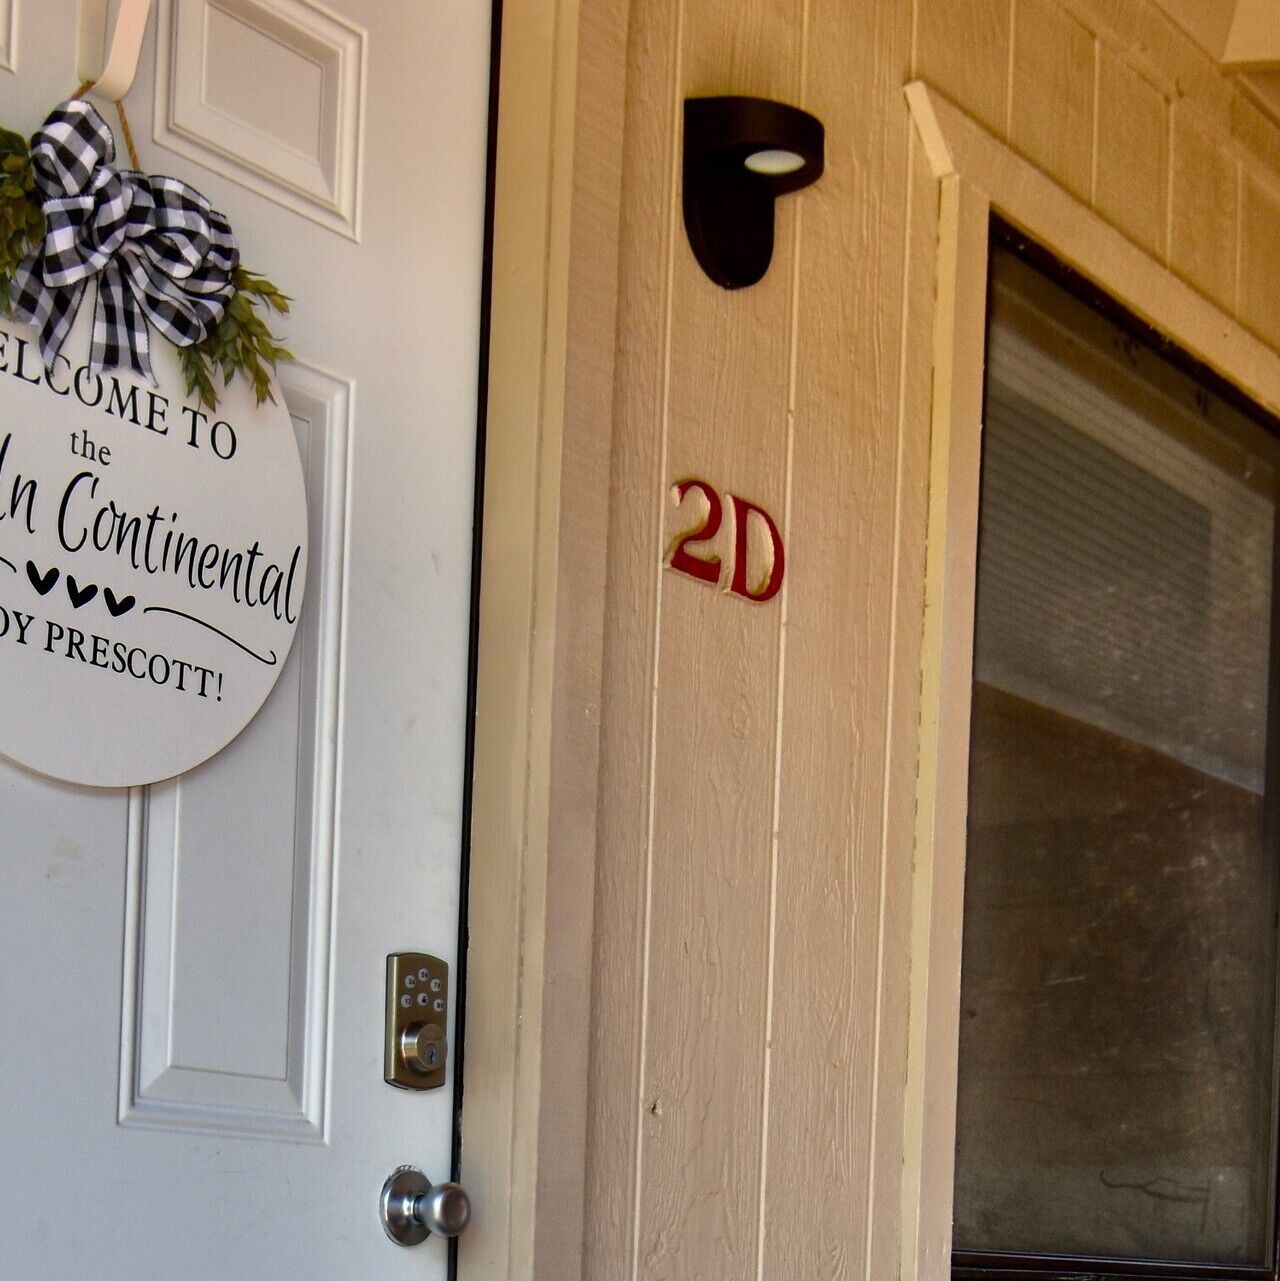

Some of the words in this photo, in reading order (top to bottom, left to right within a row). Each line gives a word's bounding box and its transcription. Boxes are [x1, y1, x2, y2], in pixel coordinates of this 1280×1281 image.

[70, 429, 111, 466] the
[181, 406, 238, 460] TO
[57, 471, 302, 624] Continental
[663, 479, 786, 604] 2D
[45, 620, 224, 702] PRESCOTT!
